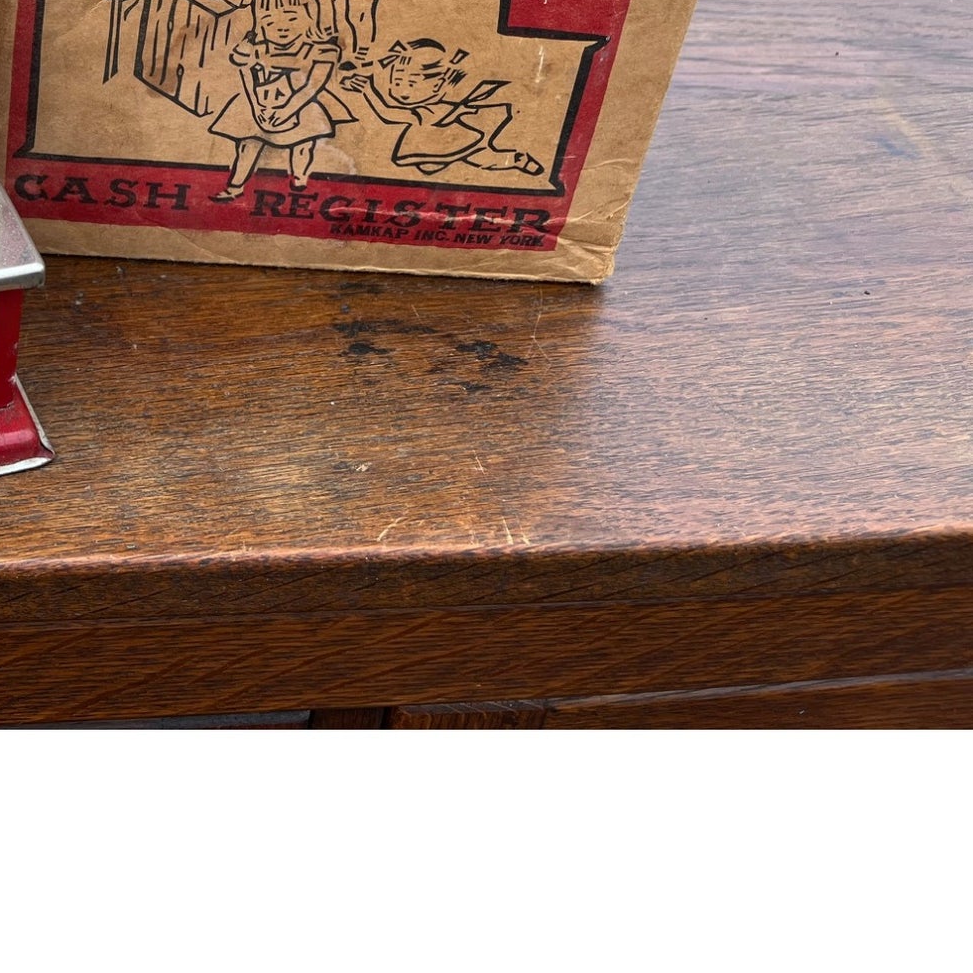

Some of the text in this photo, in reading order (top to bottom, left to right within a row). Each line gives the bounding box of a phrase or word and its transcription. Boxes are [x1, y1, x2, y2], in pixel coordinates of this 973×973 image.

[14, 174, 552, 234] CASH REGISTER
[330, 224, 544, 247] KAMKAP INC. NEW YORK
